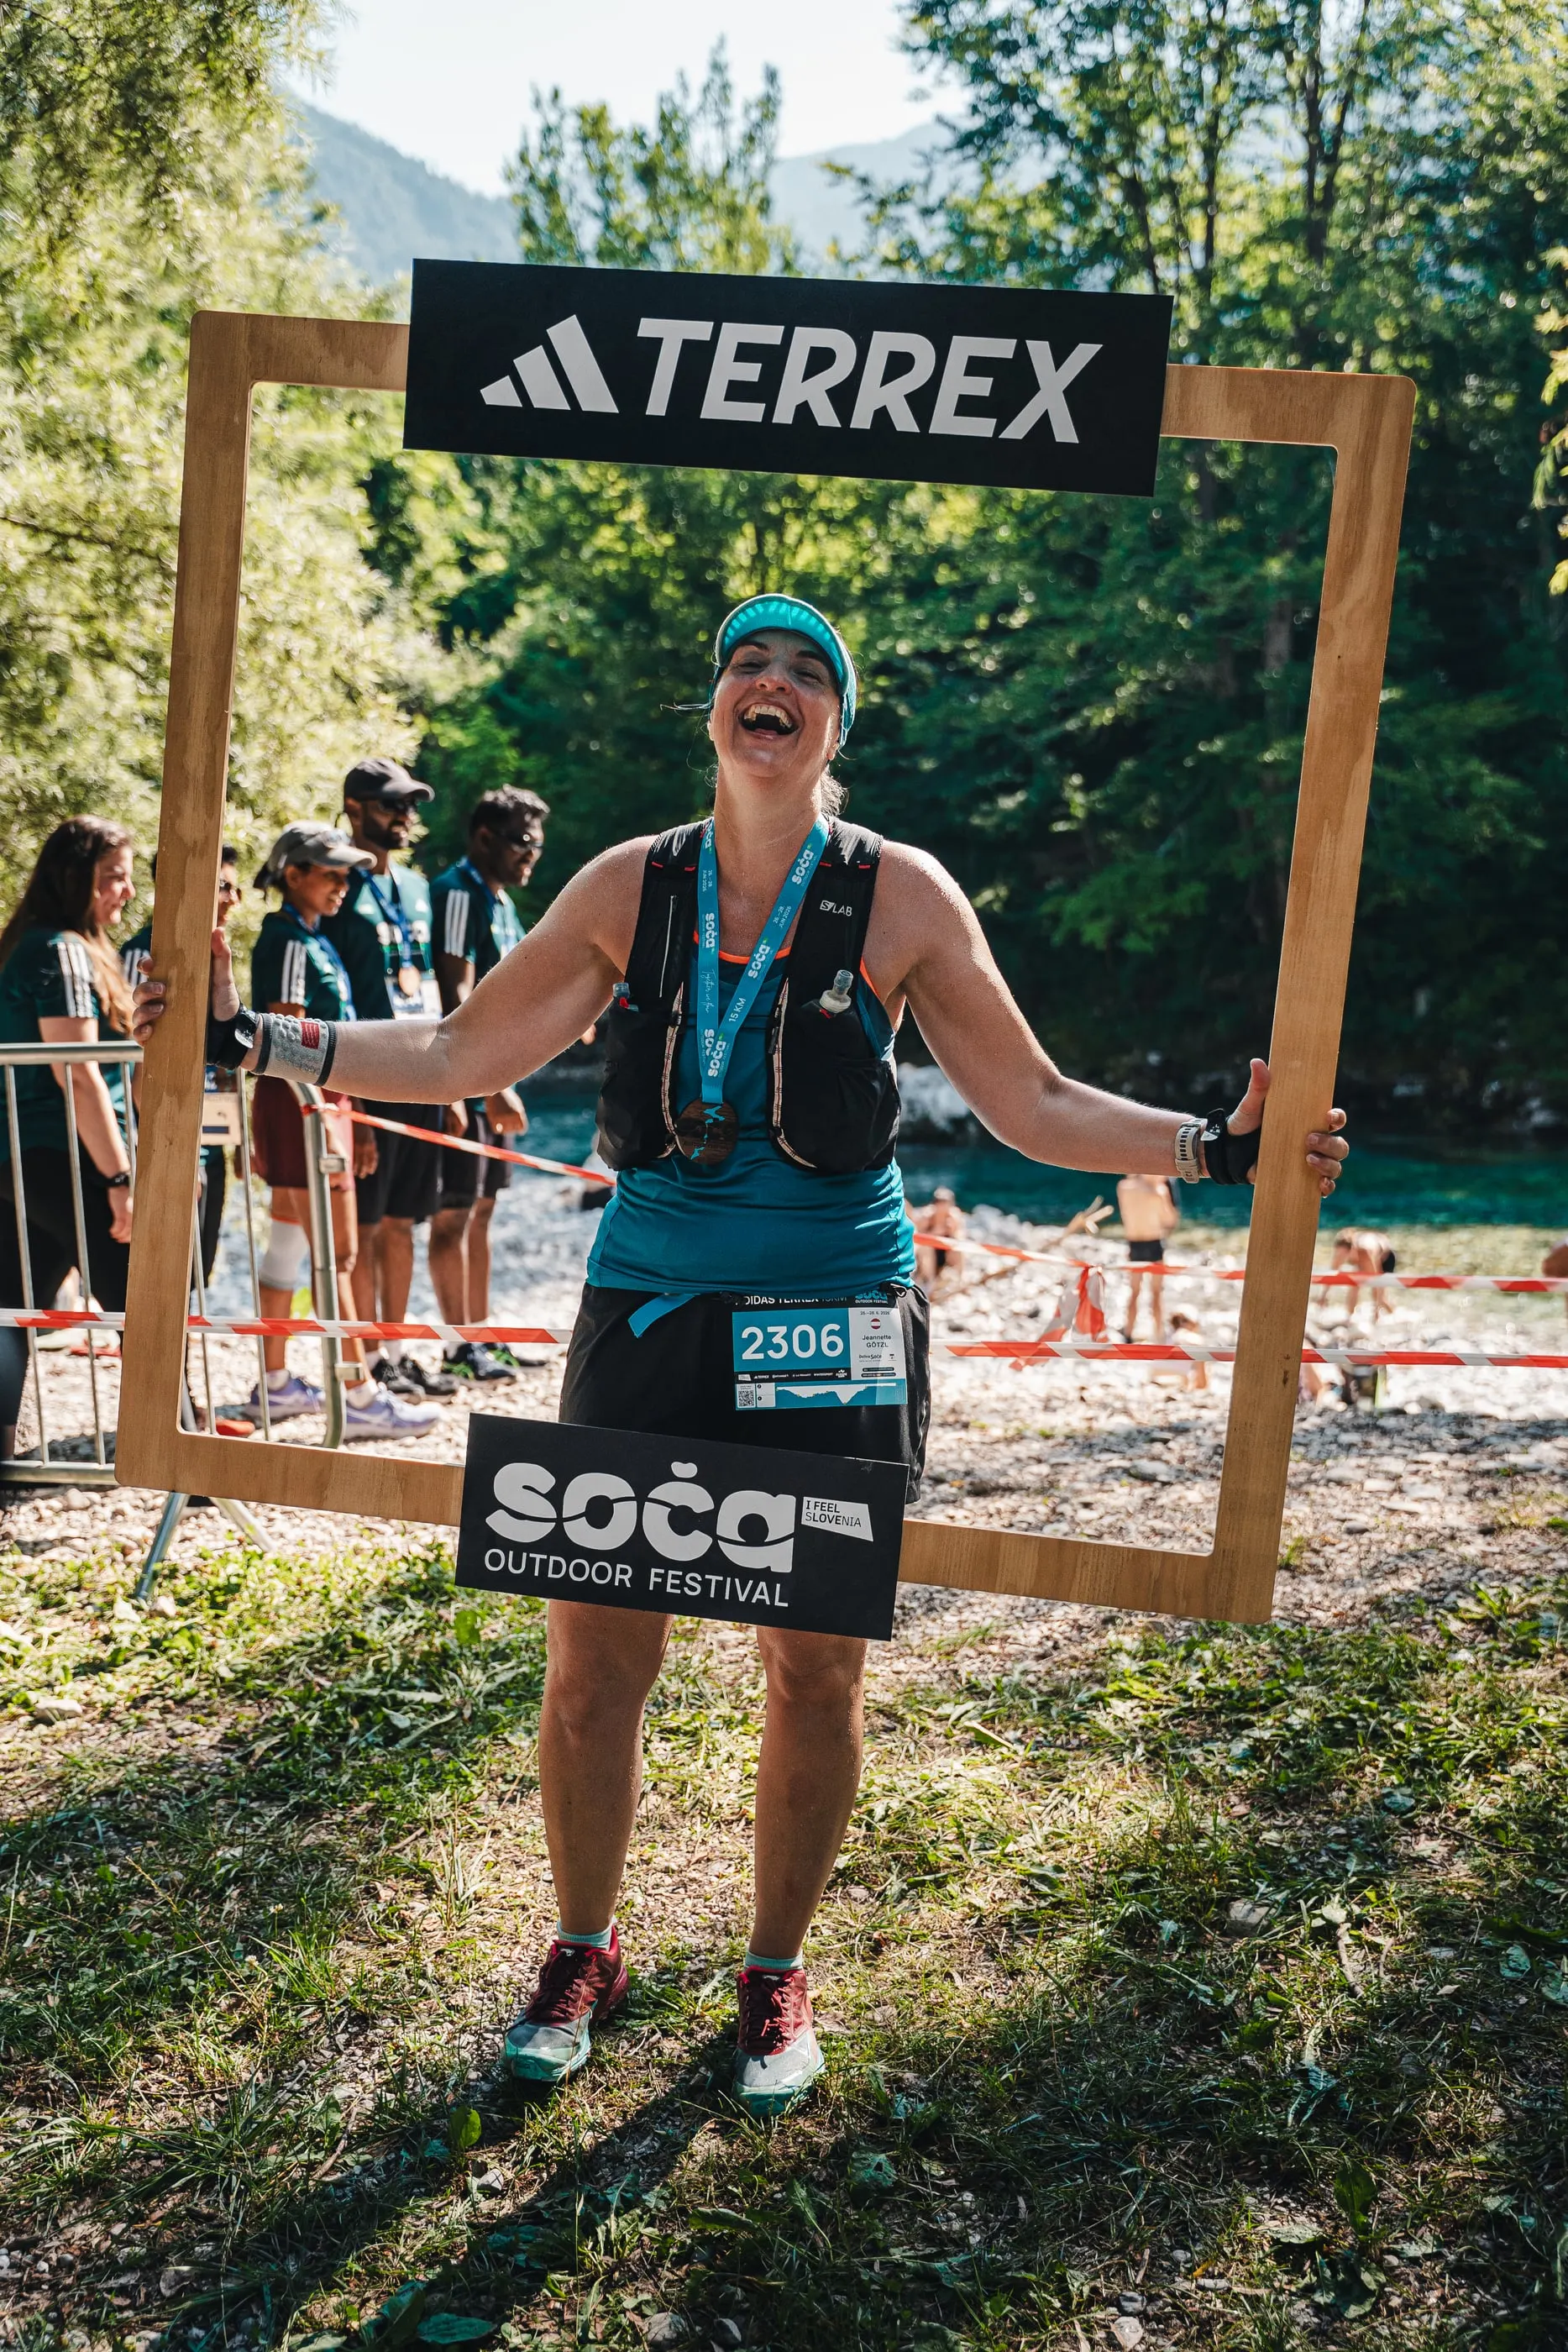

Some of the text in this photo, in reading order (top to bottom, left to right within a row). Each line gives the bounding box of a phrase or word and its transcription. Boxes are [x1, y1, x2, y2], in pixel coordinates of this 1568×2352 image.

[636, 317, 1104, 445] TERREX
[791, 848, 815, 885] soča
[705, 912, 717, 948] soča
[747, 944, 771, 979] soča
[728, 997, 747, 1023] 15 KM
[707, 1040, 726, 1078] soča
[736, 1295, 775, 1305] DIDAS
[741, 1323, 844, 1360] 2306
[485, 1461, 796, 1573] soča
[805, 1499, 841, 1514] I FEEL
[805, 1511, 862, 1528] SLOVENIA
[484, 1547, 789, 1608] OUTDOOR FESTIVAL
